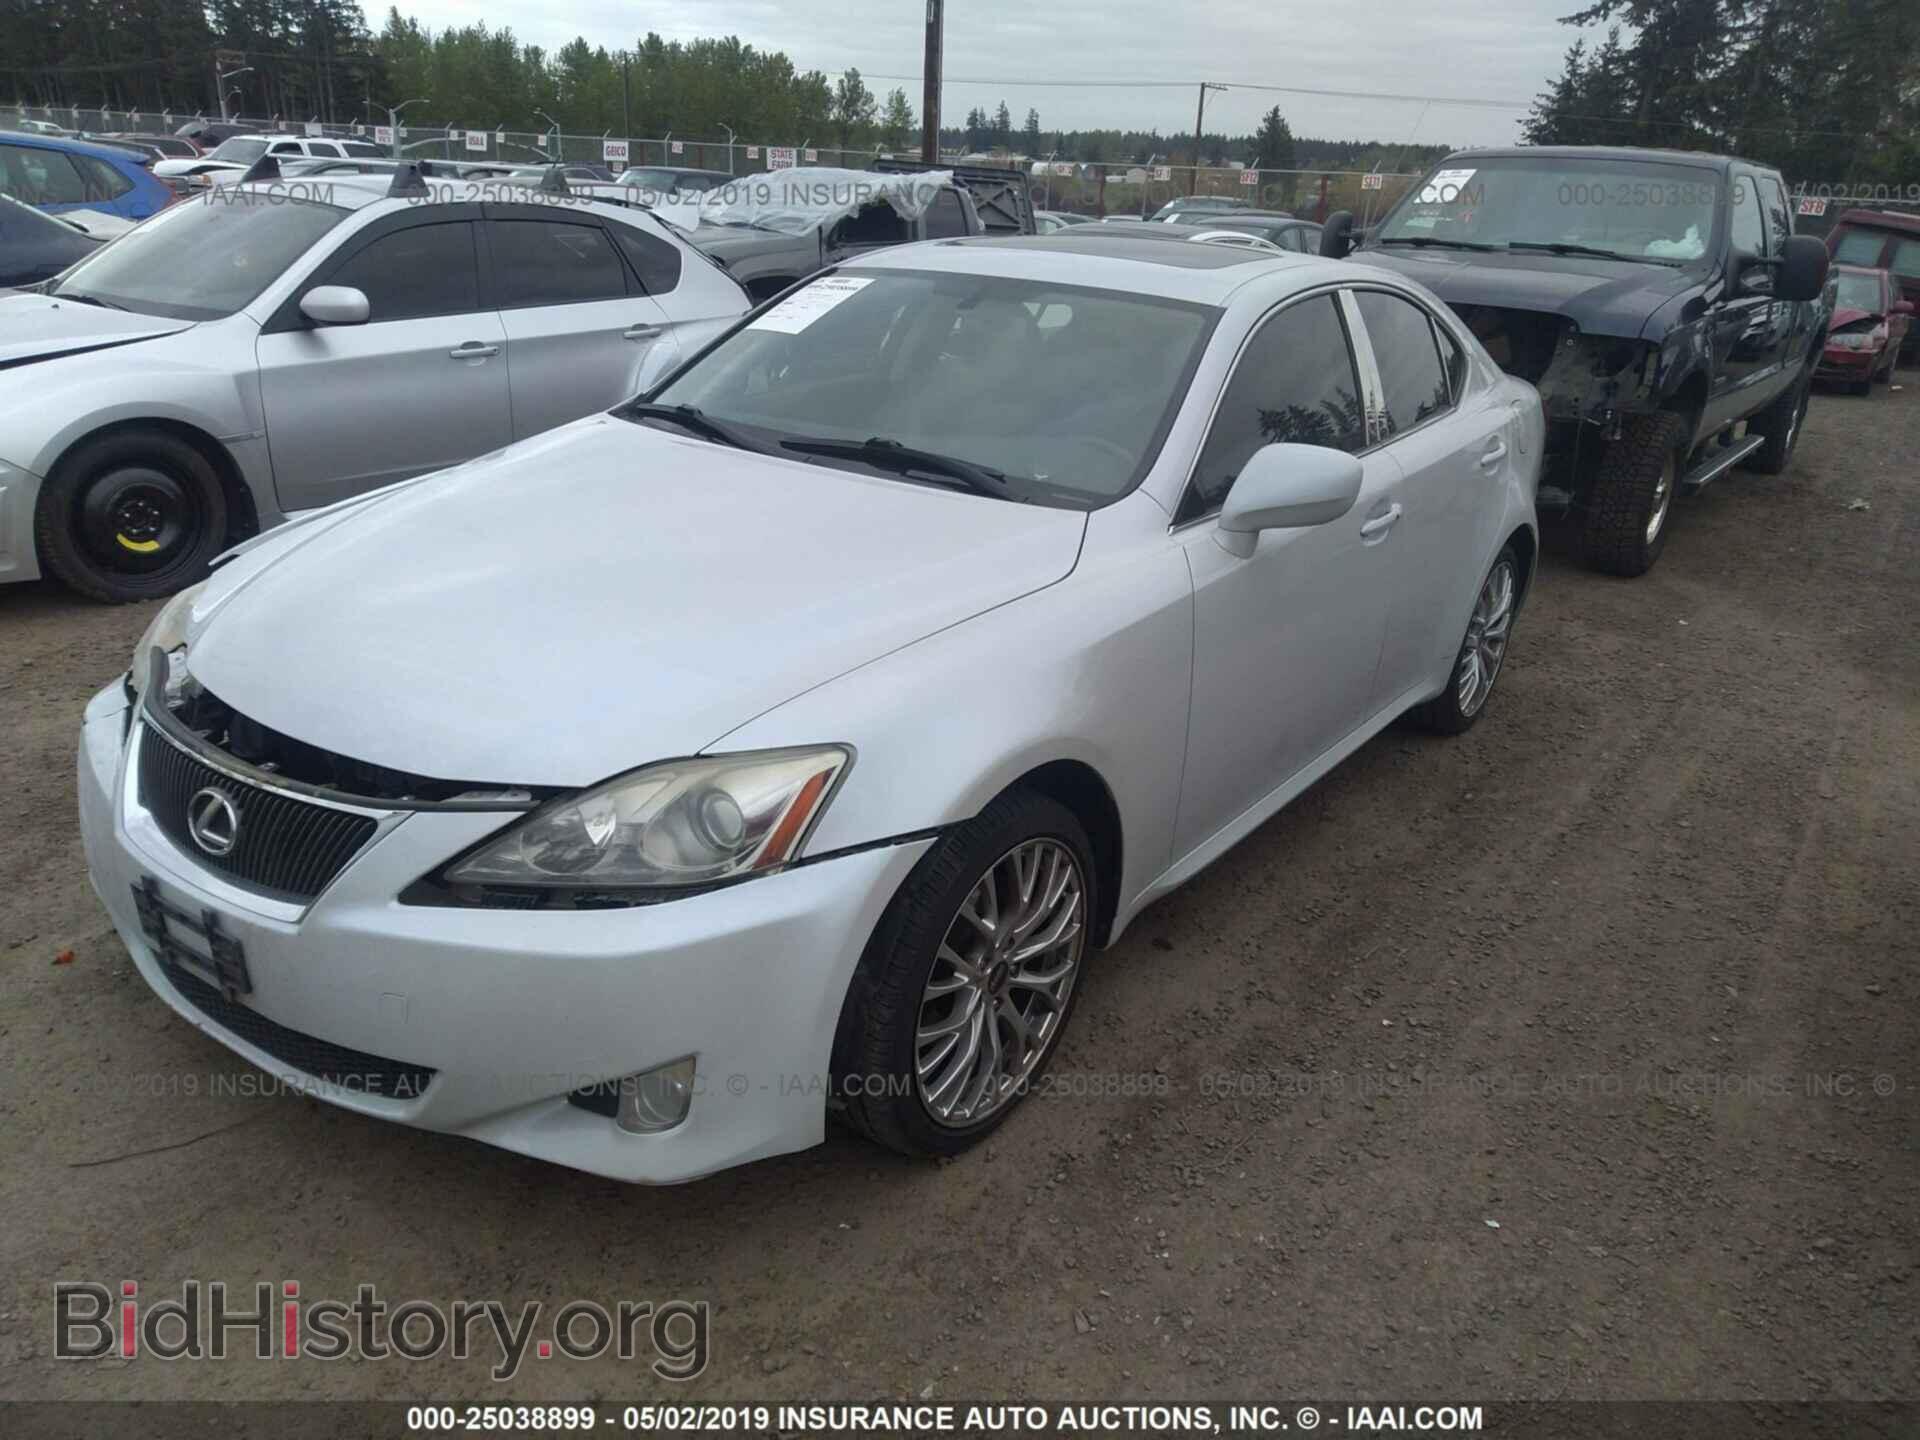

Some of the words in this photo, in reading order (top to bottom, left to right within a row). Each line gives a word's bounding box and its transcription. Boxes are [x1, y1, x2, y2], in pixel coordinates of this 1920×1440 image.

[605, 145, 626, 157] GEICO
[771, 150, 793, 160] STATE
[771, 160, 793, 169] FARM
